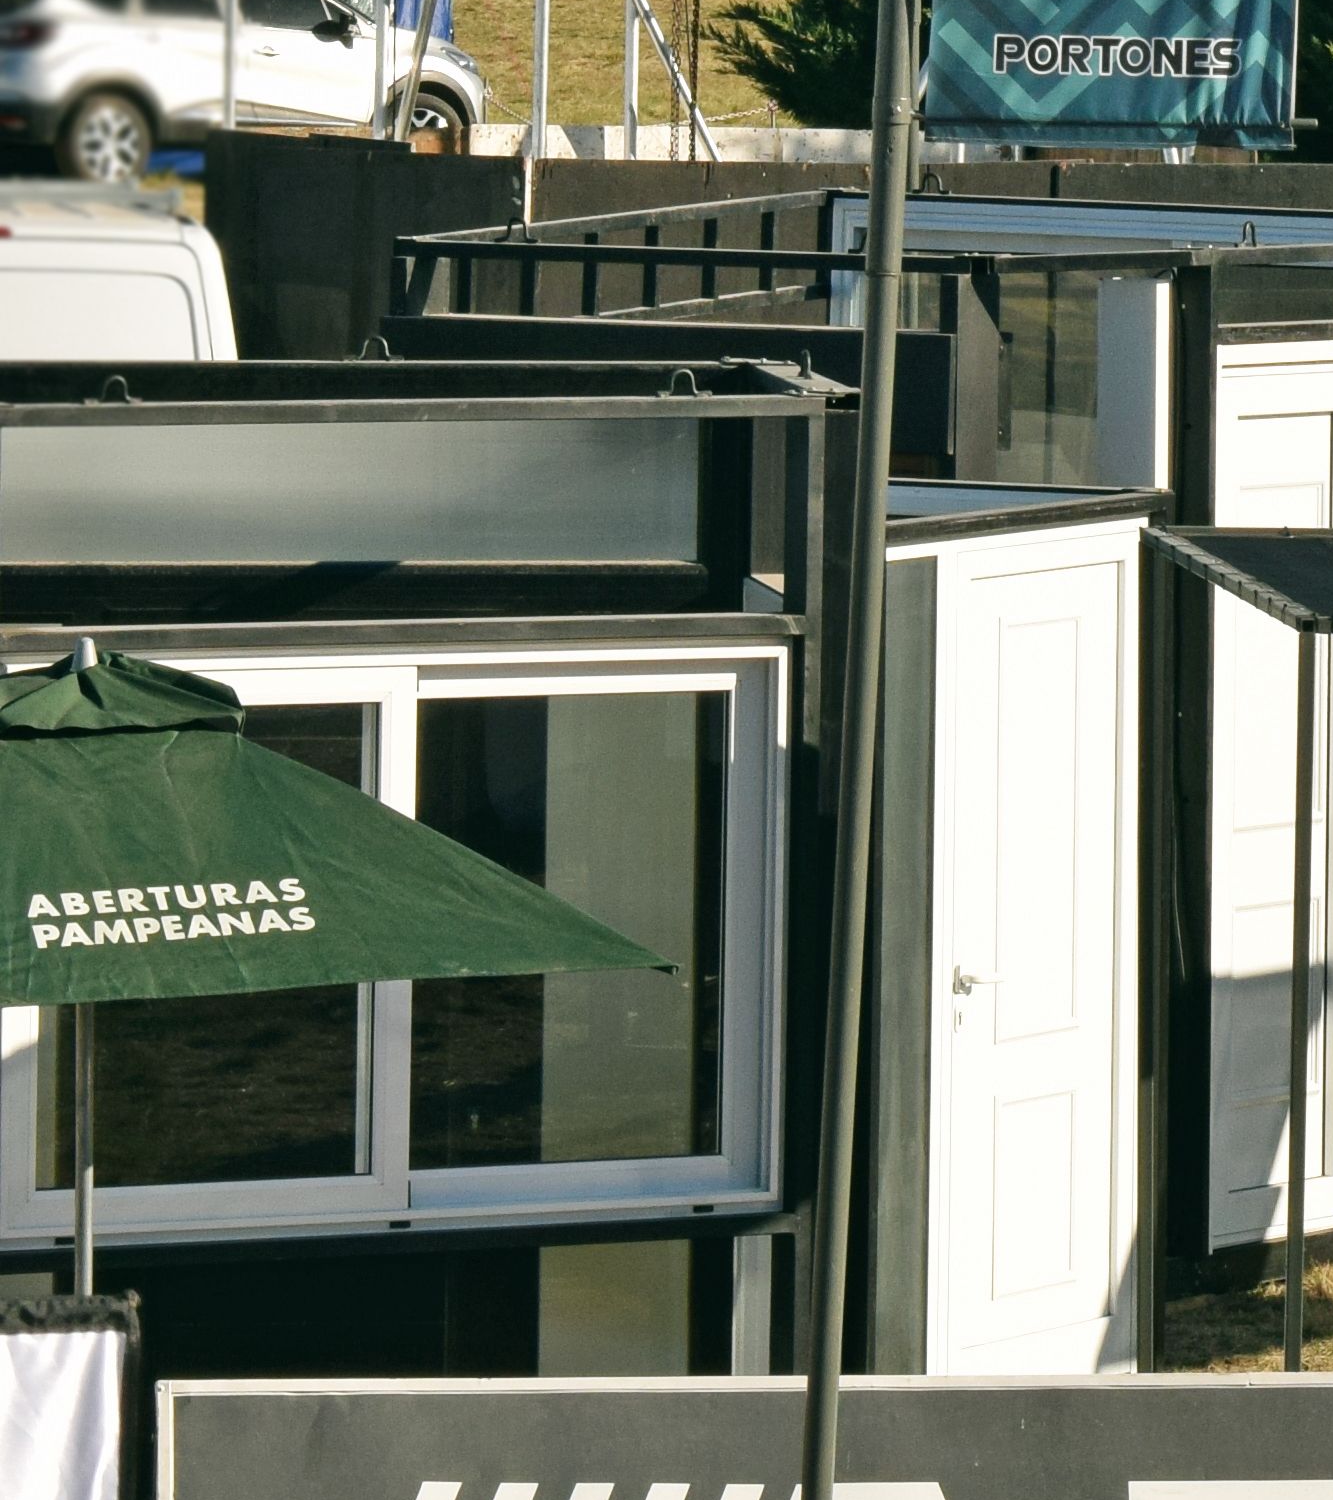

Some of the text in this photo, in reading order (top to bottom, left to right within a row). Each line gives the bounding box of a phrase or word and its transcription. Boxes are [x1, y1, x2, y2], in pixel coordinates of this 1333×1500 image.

[993, 34, 1243, 78] PORTONES
[27, 878, 306, 918] ABERTURAS
[31, 906, 316, 949] PAMPEANAS
